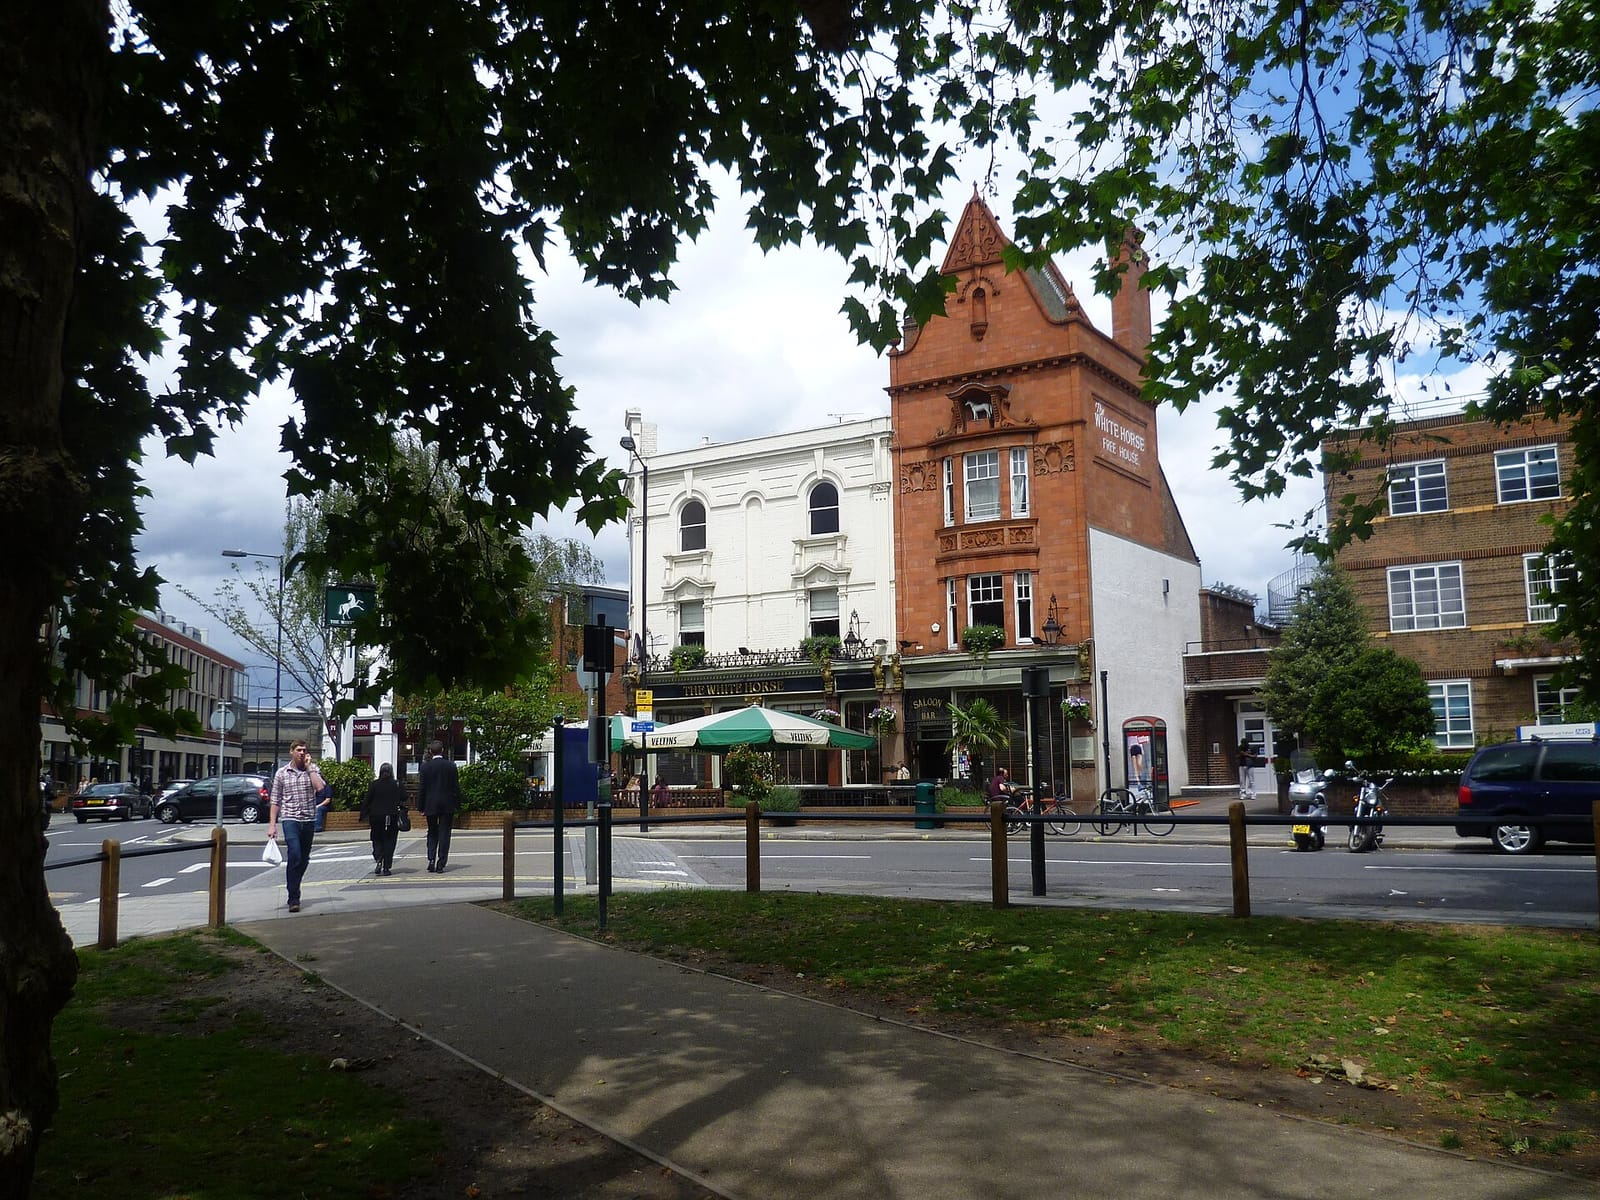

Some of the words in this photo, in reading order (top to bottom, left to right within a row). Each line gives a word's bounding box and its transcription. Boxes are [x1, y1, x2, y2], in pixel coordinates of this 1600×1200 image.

[1094, 412, 1120, 438] WHITE
[1120, 426, 1145, 452] HORSE
[1102, 437, 1117, 455] FREE
[1119, 445, 1140, 466] HOUSE
[682, 684, 704, 696] THE
[706, 682, 743, 696] WHITE
[744, 680, 785, 694] HORSE
[912, 697, 943, 710] SALOON
[921, 711, 936, 720] BAR
[651, 736, 678, 746] VELTINS
[790, 731, 813, 742] VELTINS
